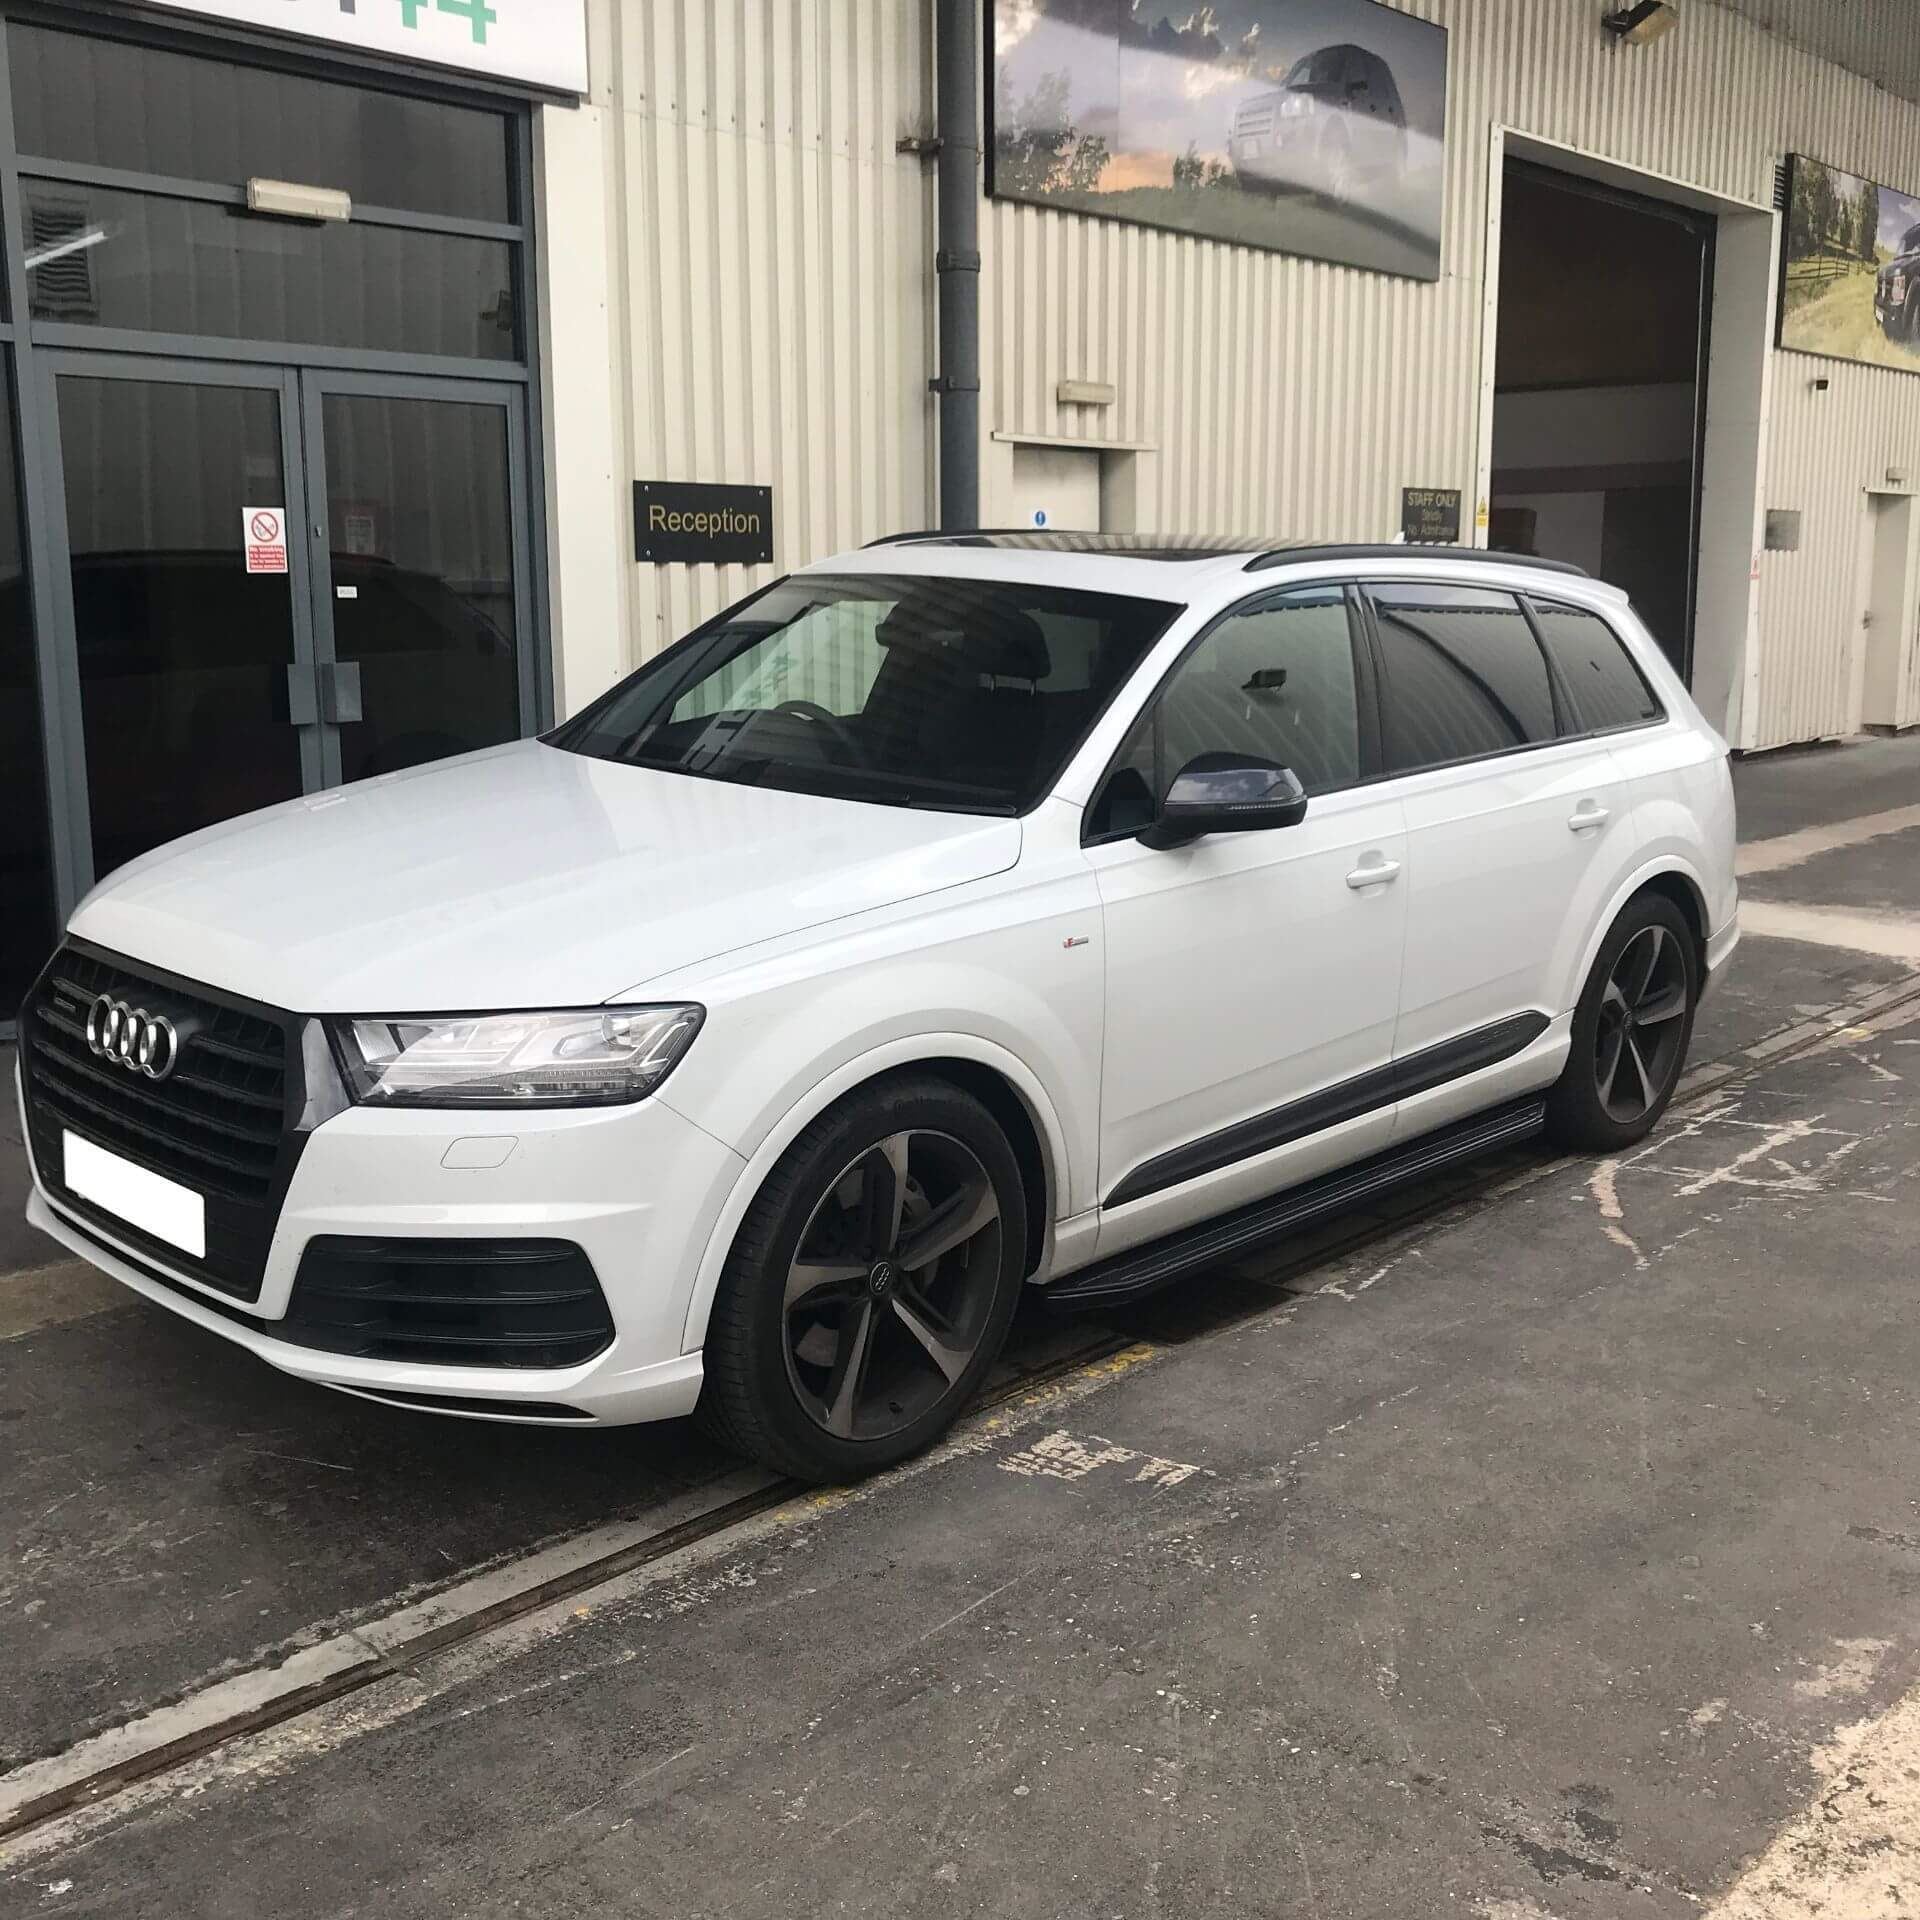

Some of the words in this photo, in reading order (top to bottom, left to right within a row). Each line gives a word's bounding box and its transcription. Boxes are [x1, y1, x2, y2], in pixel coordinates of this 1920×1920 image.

[1407, 492, 1434, 507] STAFF
[1435, 493, 1458, 508] ONLY
[649, 504, 760, 539] Reception
